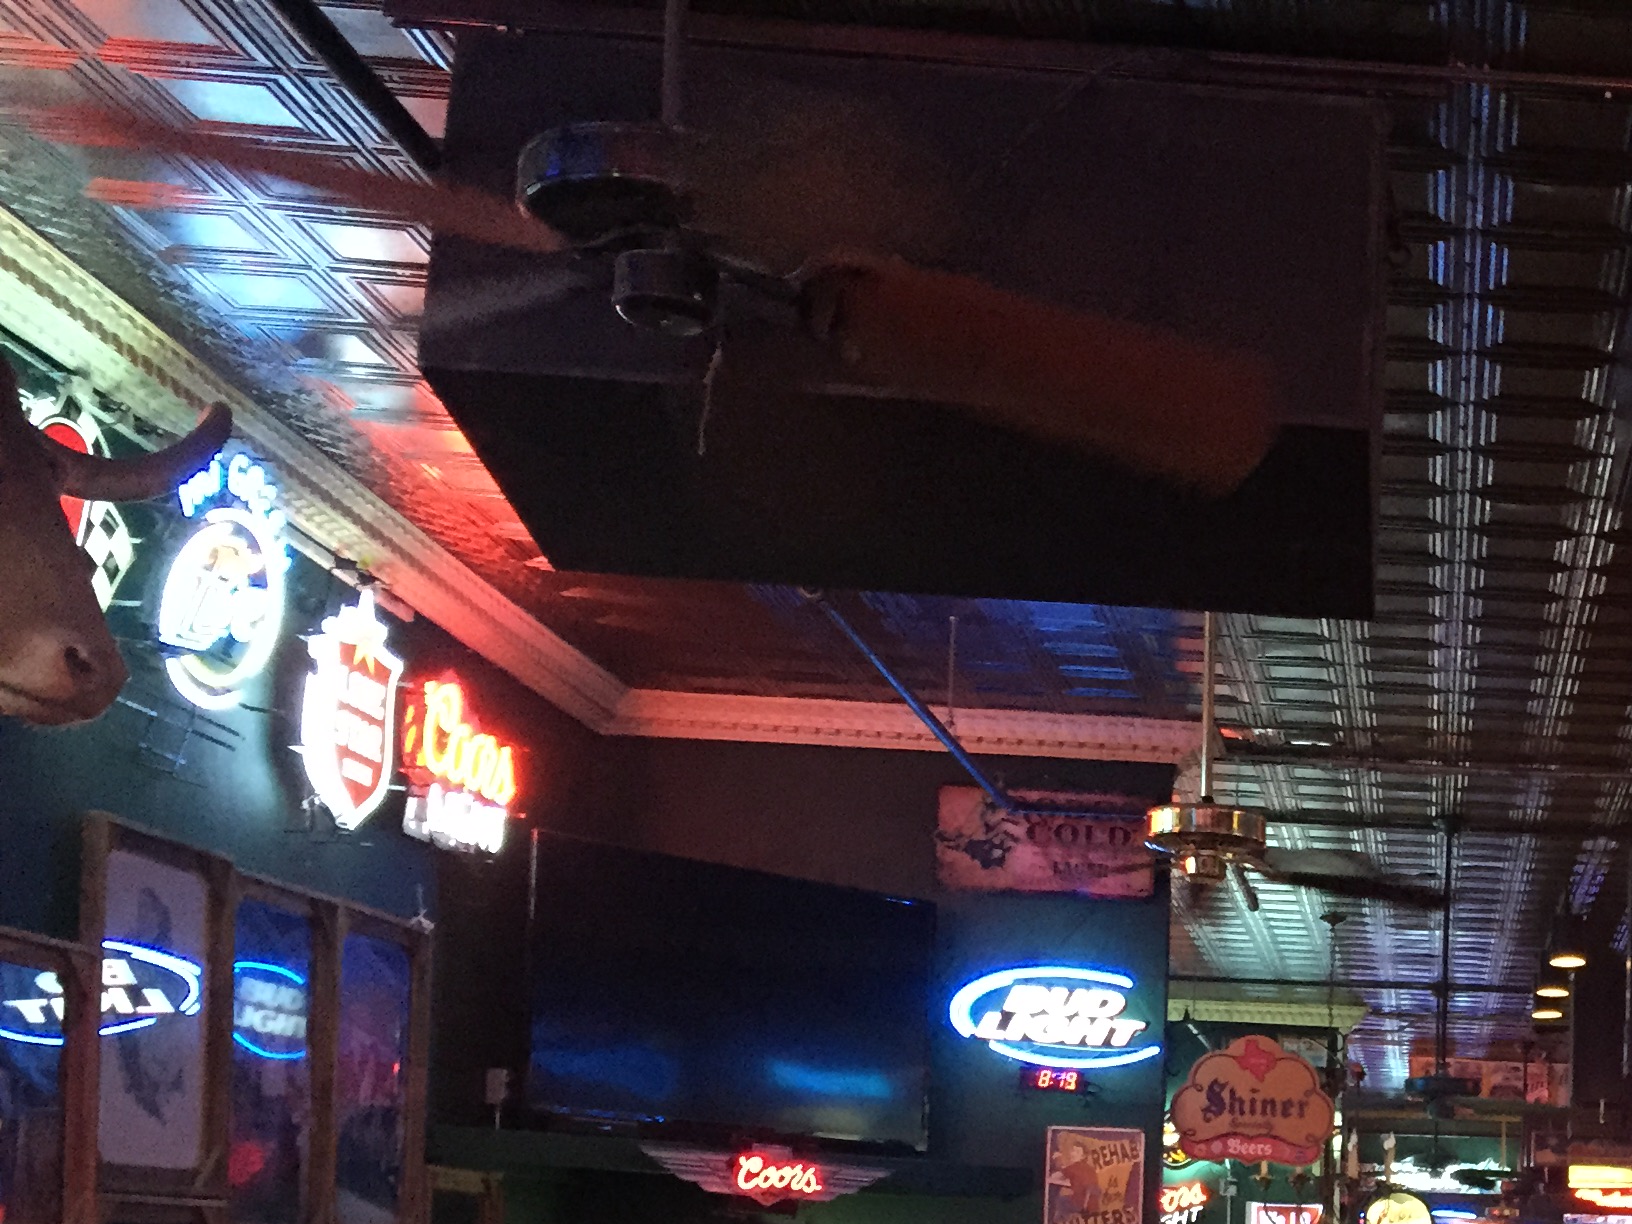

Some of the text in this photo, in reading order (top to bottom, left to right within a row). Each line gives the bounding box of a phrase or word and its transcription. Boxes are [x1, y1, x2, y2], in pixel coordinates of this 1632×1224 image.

[424, 682, 516, 805] Coors
[1003, 984, 1126, 1019] BUD
[975, 1011, 1147, 1047] LIGHT
[1202, 1078, 1309, 1123] Shiner
[1091, 1140, 1139, 1170] REHAB
[1227, 1138, 1272, 1155] Beers
[737, 1156, 822, 1193] Coors
